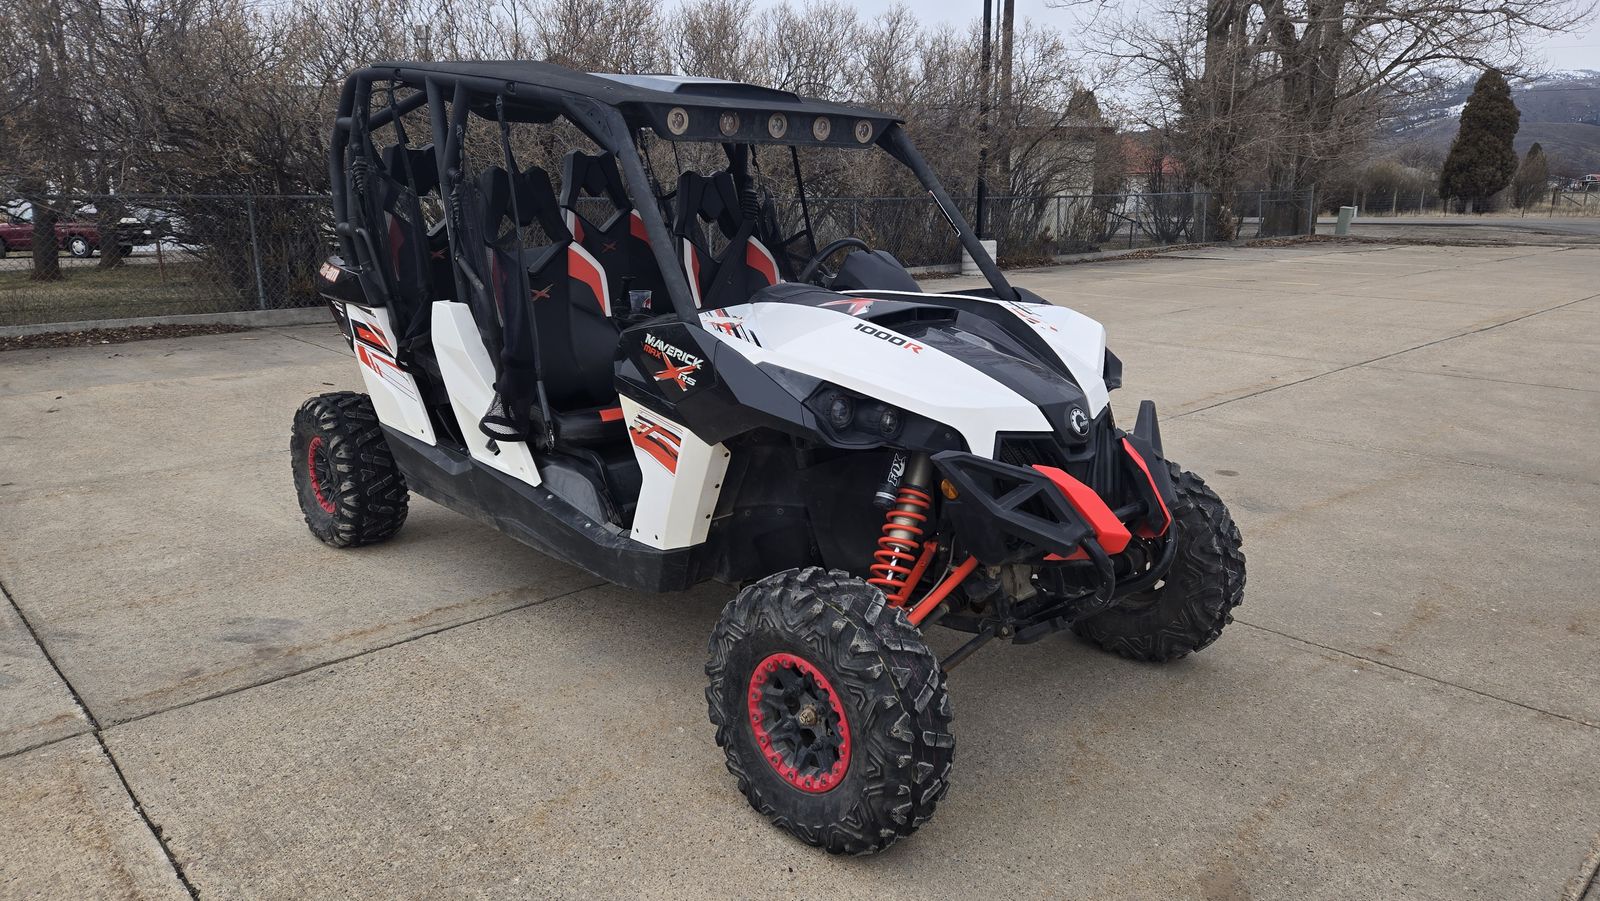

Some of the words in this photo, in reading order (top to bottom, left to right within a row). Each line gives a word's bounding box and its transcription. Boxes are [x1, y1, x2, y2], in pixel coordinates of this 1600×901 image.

[643, 344, 662, 360] MAX
[644, 333, 704, 370] MAVERICK
[853, 323, 923, 354] 1000R
